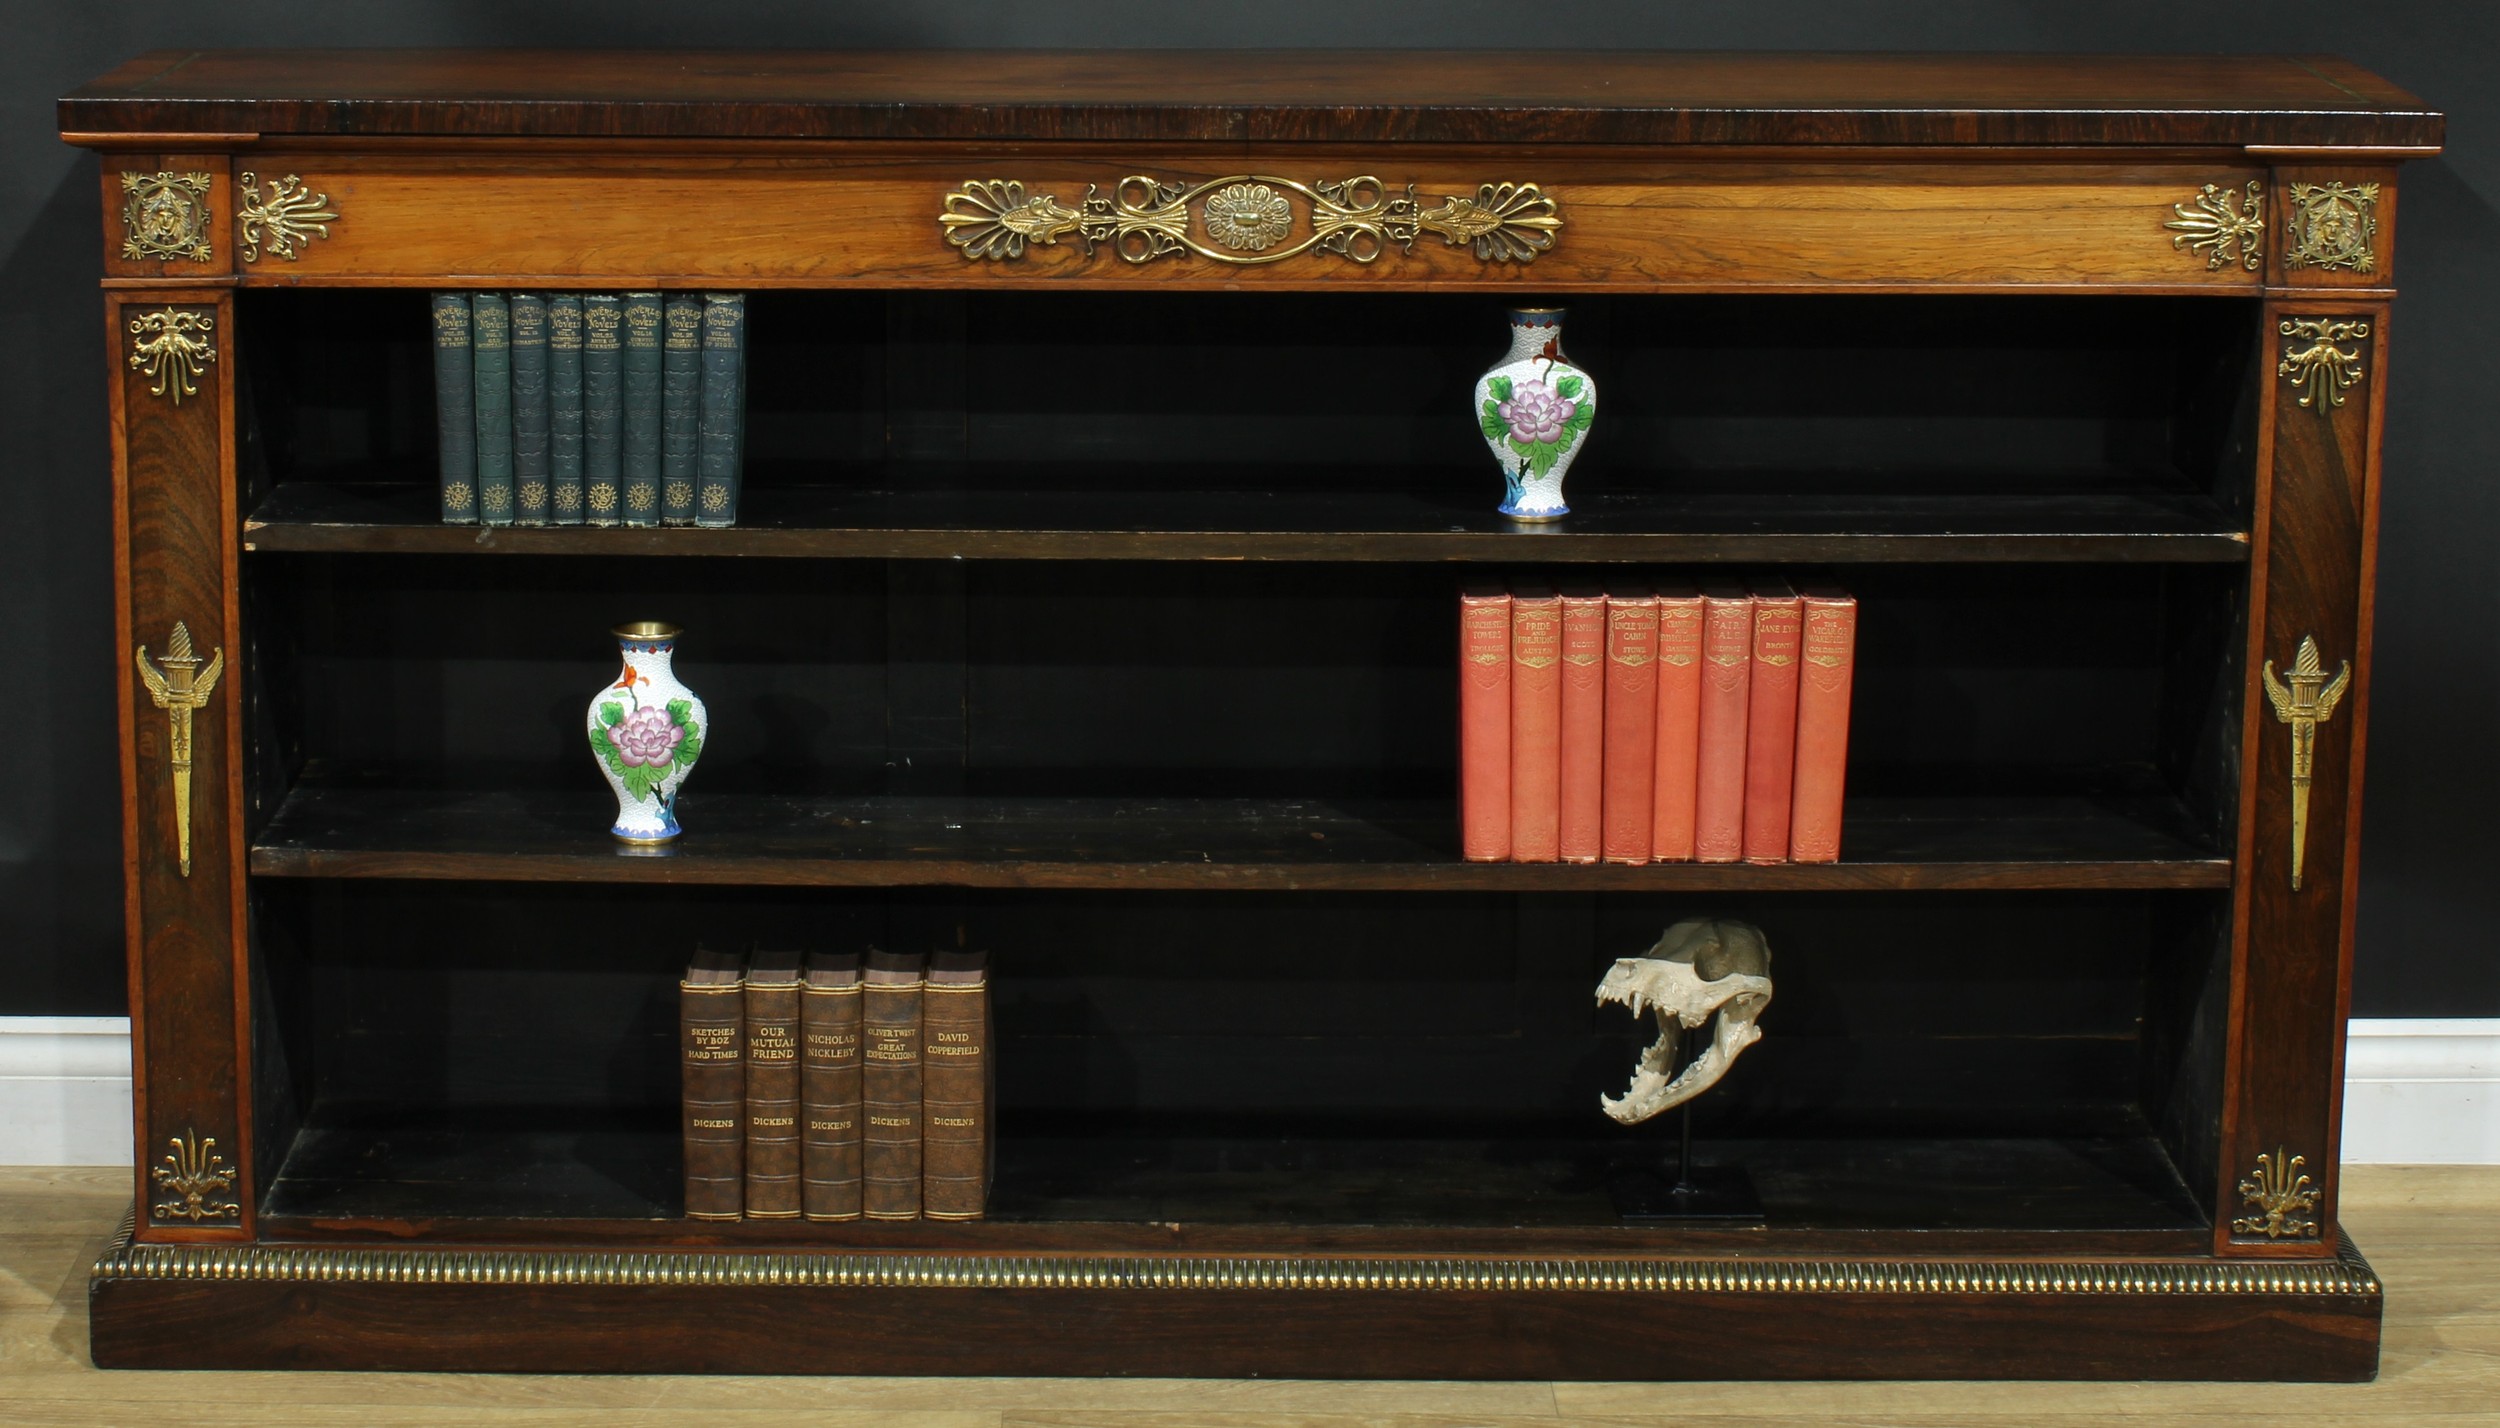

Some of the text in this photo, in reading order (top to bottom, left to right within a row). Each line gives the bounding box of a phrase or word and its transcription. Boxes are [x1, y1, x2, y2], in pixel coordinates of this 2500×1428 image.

[585, 306, 622, 320] WAVERLEY
[624, 305, 662, 320] WAVERLEY
[667, 306, 702, 321] WAVERLEY
[704, 305, 744, 321] WAVERLEY
[438, 316, 469, 329] NOVELS
[478, 317, 509, 329] NOVELS
[514, 314, 543, 328] NOVELS
[552, 317, 581, 329] NOVELS
[588, 317, 618, 329] NOVELS
[628, 314, 658, 327] NOVELS
[669, 316, 698, 329] NOVELS
[707, 315, 736, 328] NOVELS
[1526, 622, 1551, 631] PRIDE
[1564, 623, 1600, 632] IVANHO
[1615, 622, 1636, 631] UNCLE
[1713, 621, 1746, 630] FAIRY
[1760, 624, 1780, 633] JANE
[1812, 626, 1836, 635] VICAR
[1473, 631, 1503, 639] TOWERS
[1518, 636, 1560, 644] PREJUDICE
[1623, 632, 1647, 641] CABIN
[1808, 635, 1850, 644] WAKEFIELD
[691, 1028, 736, 1036] SKETCHES
[760, 1027, 785, 1037] OUR
[868, 1028, 916, 1037] OLIVER TWIST
[938, 1032, 970, 1042] DAVID
[696, 1036, 730, 1045] BY BOZ
[751, 1038, 796, 1048] MUTUAL
[807, 1034, 856, 1045] NICHOLAS
[807, 1047, 856, 1058] NICKLEBY
[877, 1043, 906, 1052] GREAT
[927, 1045, 980, 1056] COPPERFIELD
[688, 1050, 739, 1059] HARD TIMES
[753, 1049, 795, 1059] FRIEND
[866, 1050, 917, 1060] EXPECTATIONS
[693, 1119, 735, 1128] DICKENS
[753, 1117, 794, 1126] DICKENS
[811, 1121, 852, 1130] DICKENS
[871, 1116, 911, 1126] DICKENS
[934, 1117, 975, 1127] DICKENS
